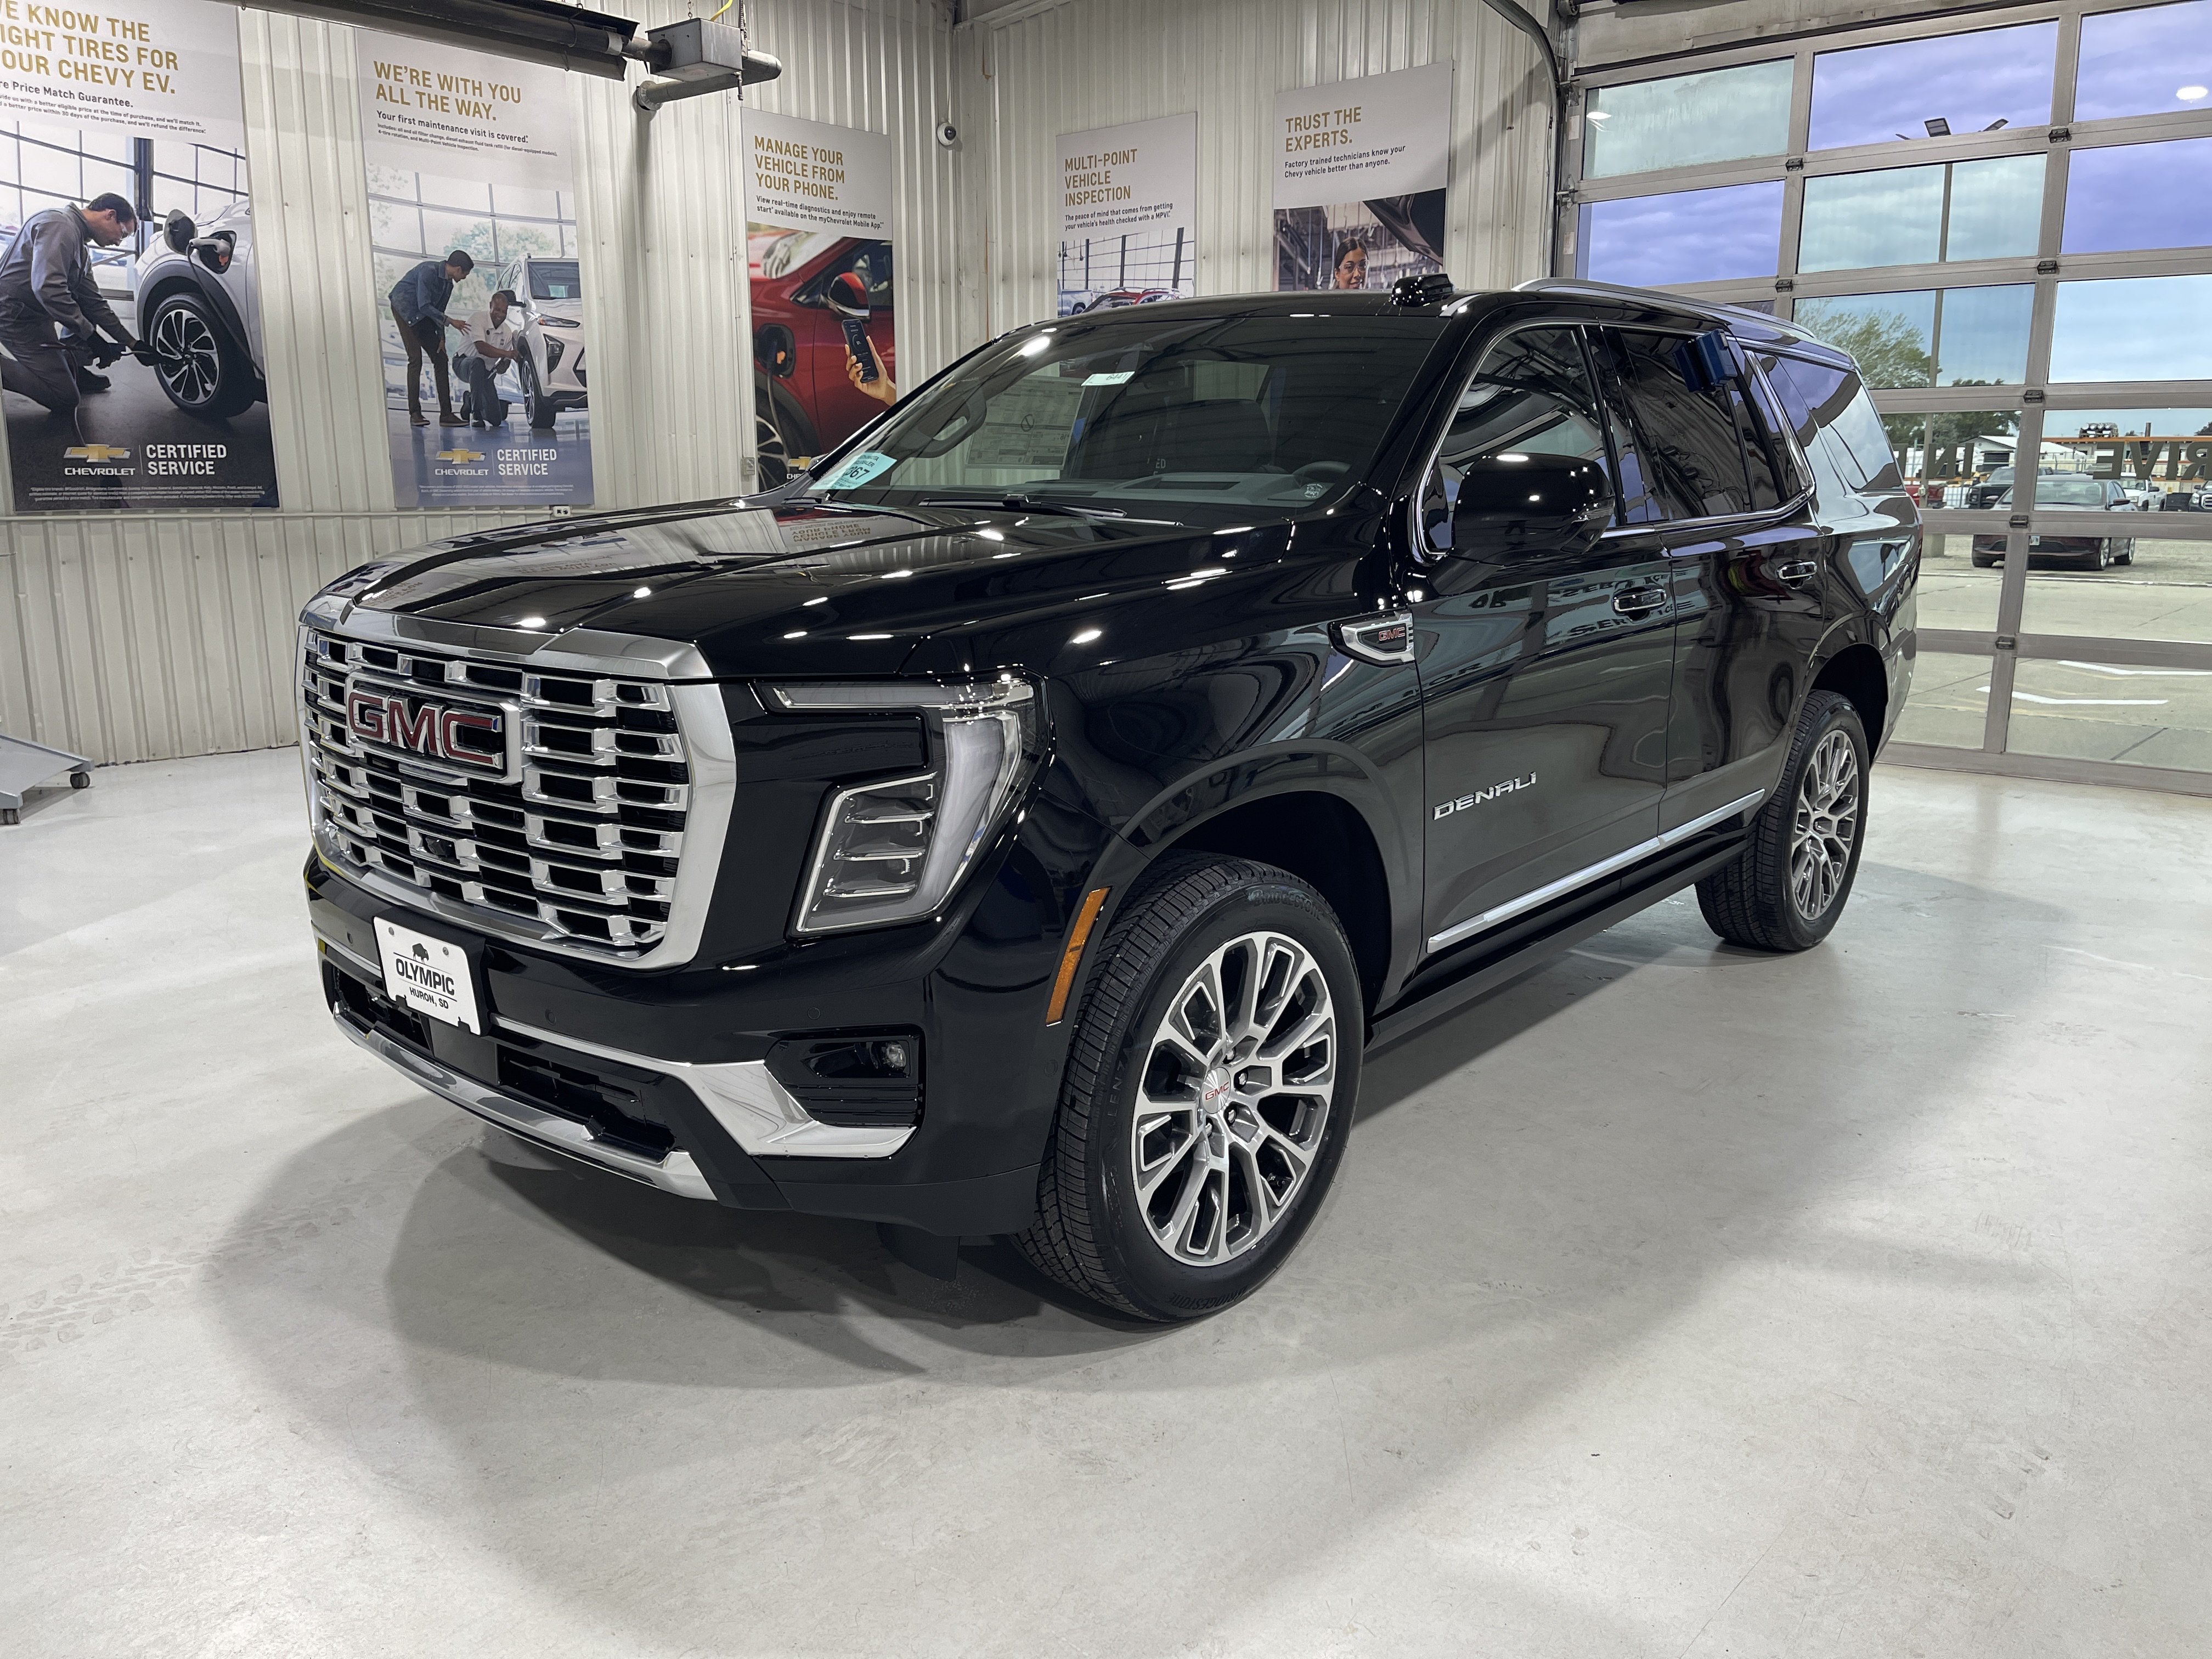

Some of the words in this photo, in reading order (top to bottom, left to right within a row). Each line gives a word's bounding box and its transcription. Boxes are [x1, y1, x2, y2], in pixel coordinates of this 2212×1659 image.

[0, 0, 19, 20] E
[27, 4, 98, 33] KNOW
[106, 17, 150, 42] THE
[0, 24, 55, 51] IGHT
[65, 35, 129, 63] TIRES
[137, 46, 178, 70] FOR
[2, 49, 50, 76] OUR
[58, 59, 134, 88] CHEVY
[142, 71, 174, 94] EV.
[374, 60, 432, 88] WE'RE
[437, 73, 482, 97] WITH
[488, 82, 520, 103] YOU
[13, 81, 40, 94] Price
[43, 86, 75, 99] Match
[78, 92, 133, 108] Guarantee.
[376, 83, 410, 105] ALL
[415, 91, 450, 113] THE
[455, 98, 496, 121] WAY.
[376, 110, 396, 121] Your
[398, 114, 415, 125] first
[417, 120, 468, 134] maintenance
[470, 127, 486, 137] visit
[1285, 111, 1330, 133] TRUST
[1334, 106, 1362, 126] THE
[754, 136, 807, 160] MANAGE
[811, 146, 843, 166] YOUR
[1285, 129, 1352, 152] EXPERTS.
[1065, 148, 1138, 172] MULTI-POINT
[1285, 160, 1308, 168] Factory
[1310, 155, 1331, 165] trained
[1334, 151, 1369, 162] technicians
[1390, 145, 1406, 155] your
[1305, 166, 1325, 176] vehicle
[1365, 159, 1390, 168] anyone.
[755, 154, 808, 178] VEHICLE
[812, 165, 845, 184] FROM
[1064, 170, 1110, 189] VEHICLE
[755, 172, 789, 192] YOUR
[793, 179, 838, 200] PHONE.
[1065, 185, 1130, 206] INSPECTION
[756, 195, 770, 204] View
[771, 199, 798, 209] real-time
[799, 202, 830, 214] diagnostics
[842, 210, 856, 219] enjoy
[774, 209, 798, 218] available
[819, 216, 851, 225] myChevrolet
[853, 218, 870, 228] Mobile
[1075, 213, 1089, 222] peace
[1097, 209, 1109, 217] mind
[1139, 205, 1152, 214] from
[1153, 202, 1172, 213] getting
[1065, 223, 1076, 232] your
[1077, 219, 1097, 228] vehicle's
[1116, 215, 1137, 224] checked
[146, 444, 227, 459] CERTIFIED
[496, 448, 557, 461] CERTIFIED
[64, 467, 136, 476] CHEVROLET
[148, 461, 215, 476] SERVICE
[498, 463, 549, 476] SERVICE
[1379, 627, 1406, 641] GMC
[347, 686, 504, 770] GMC
[1432, 771, 1536, 820] DENALI
[396, 958, 455, 996] OLYMPIC
[409, 987, 437, 1007] HURON,
[439, 998, 449, 1009] SD
[1205, 1081, 1229, 1101] GMC
